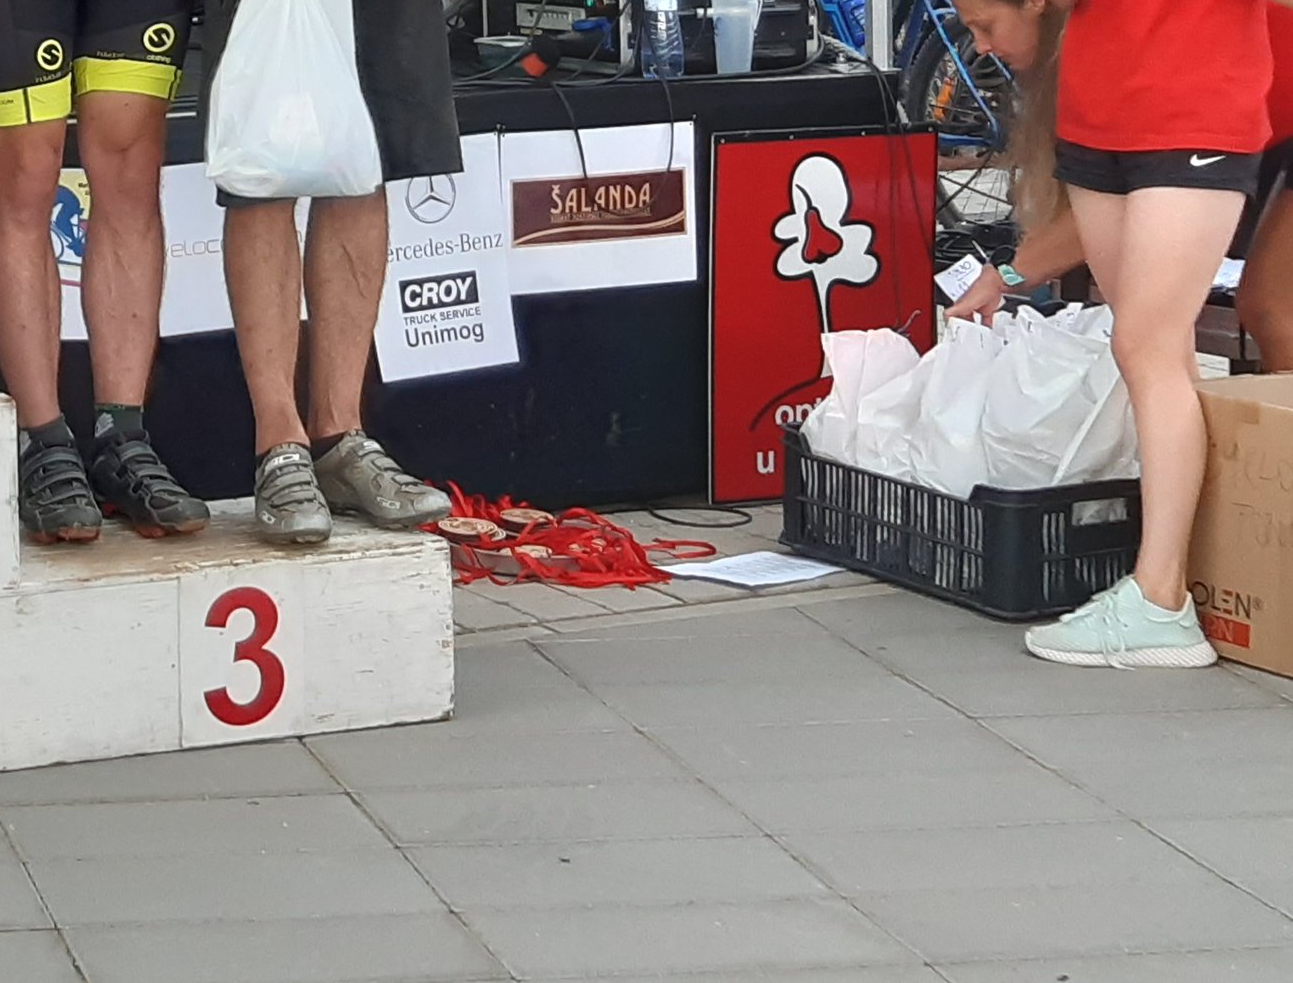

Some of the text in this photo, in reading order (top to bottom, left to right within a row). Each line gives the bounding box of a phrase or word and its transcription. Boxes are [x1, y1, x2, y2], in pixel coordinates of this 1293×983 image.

[549, 182, 651, 214] ŠALANDA
[387, 232, 504, 263] ercedes-Benz
[404, 276, 473, 308] CROY
[403, 306, 482, 326] TRUCK SERVICE
[405, 322, 485, 348] Unimog
[756, 450, 775, 474] u
[203, 587, 285, 726] 3
